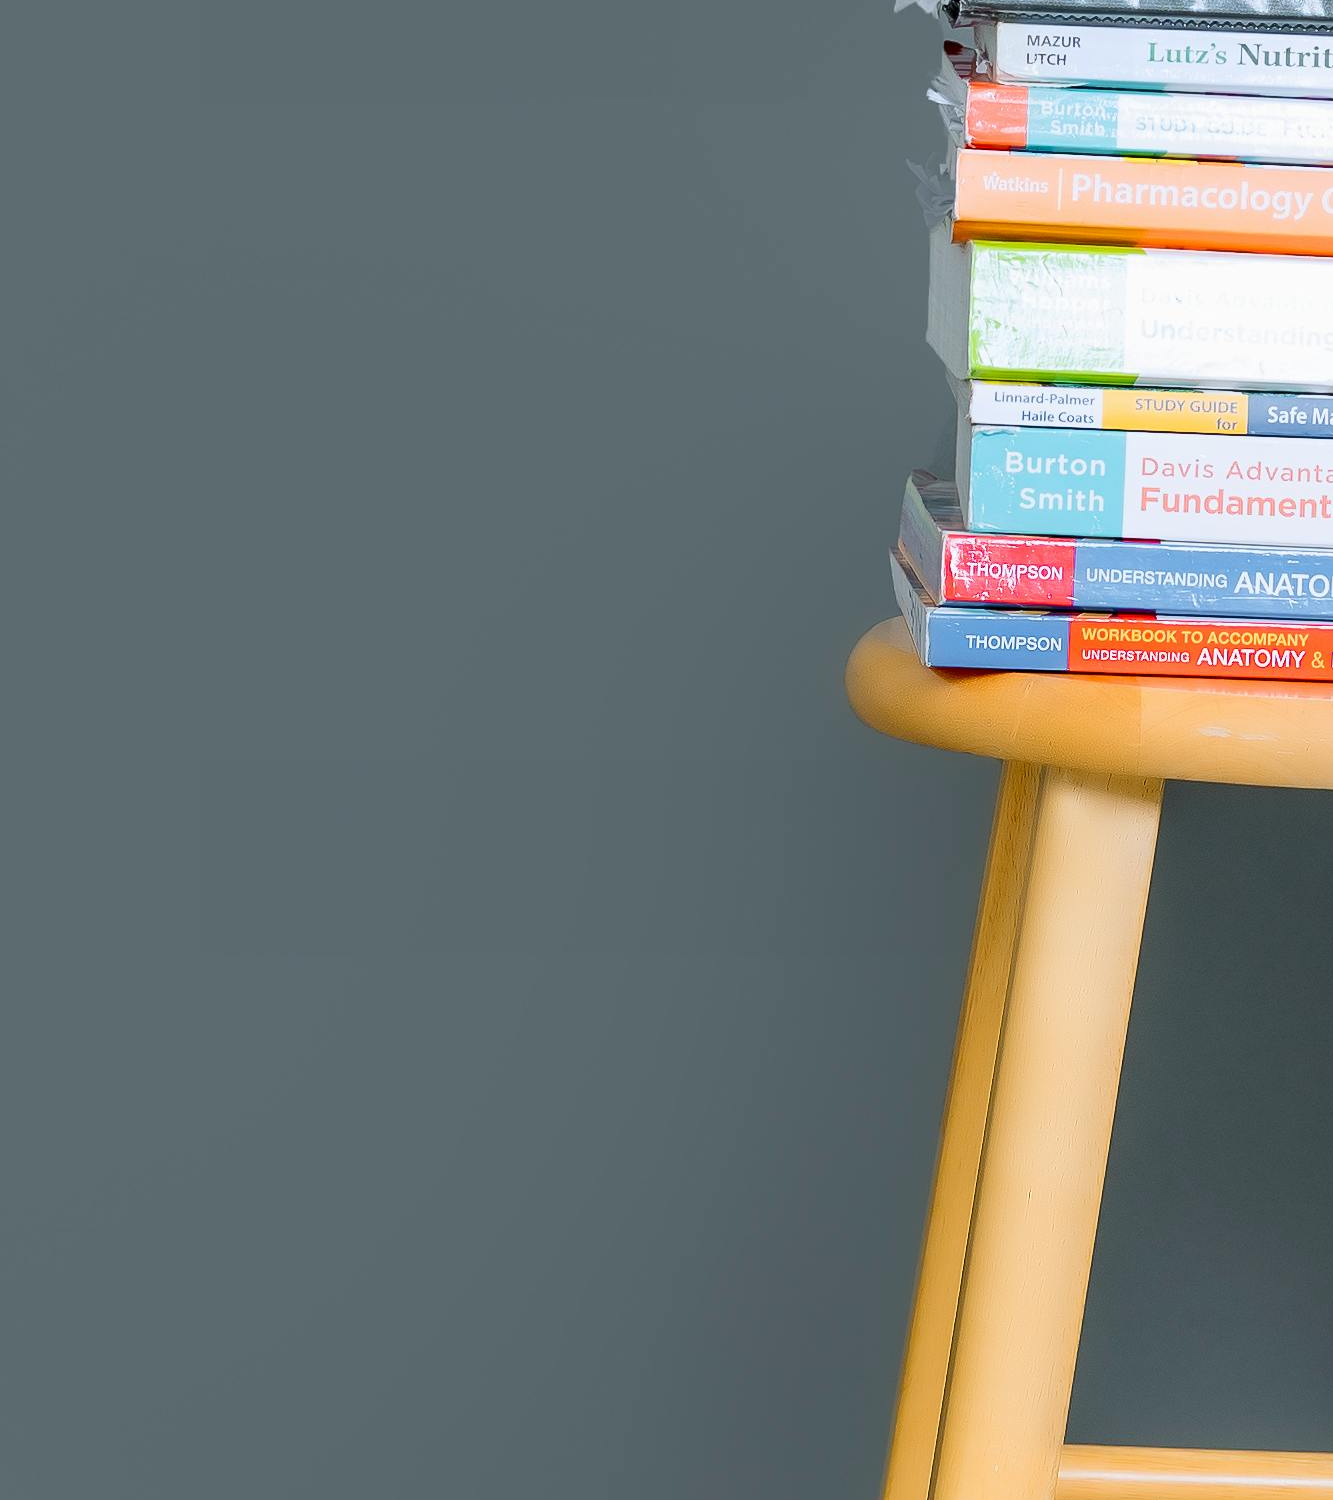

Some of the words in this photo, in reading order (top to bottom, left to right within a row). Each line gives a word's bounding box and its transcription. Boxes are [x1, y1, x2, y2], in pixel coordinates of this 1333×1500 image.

[1026, 34, 1081, 48] MAZUR
[1041, 101, 1105, 117] Burton
[1051, 121, 1105, 136] Smith
[983, 172, 1049, 195] Watkins
[1071, 173, 1313, 219] Pharmacology
[994, 391, 1096, 407] Linnard-Palmer
[1135, 398, 1185, 413] STUDY
[1190, 400, 1239, 414] GUIDE
[1021, 411, 1055, 424] Haile
[1058, 411, 1095, 424] Coats
[1267, 405, 1308, 425] Safe
[1216, 417, 1238, 432] for
[1005, 451, 1106, 478] Burton
[1141, 458, 1214, 479] Davis
[1019, 488, 1105, 513] Smith
[967, 562, 1063, 580] THOMPSON
[1086, 568, 1228, 588] UNDERSTANDING
[966, 634, 1062, 651] THOMPSON
[1081, 628, 1177, 644] WORKBOOK
[1181, 630, 1205, 644] TO
[1207, 631, 1309, 647] ACCOMPANY
[1081, 648, 1190, 663] UNDERSTANDING
[1196, 647, 1306, 669] ANATOMY
[1310, 652, 1326, 669] &
